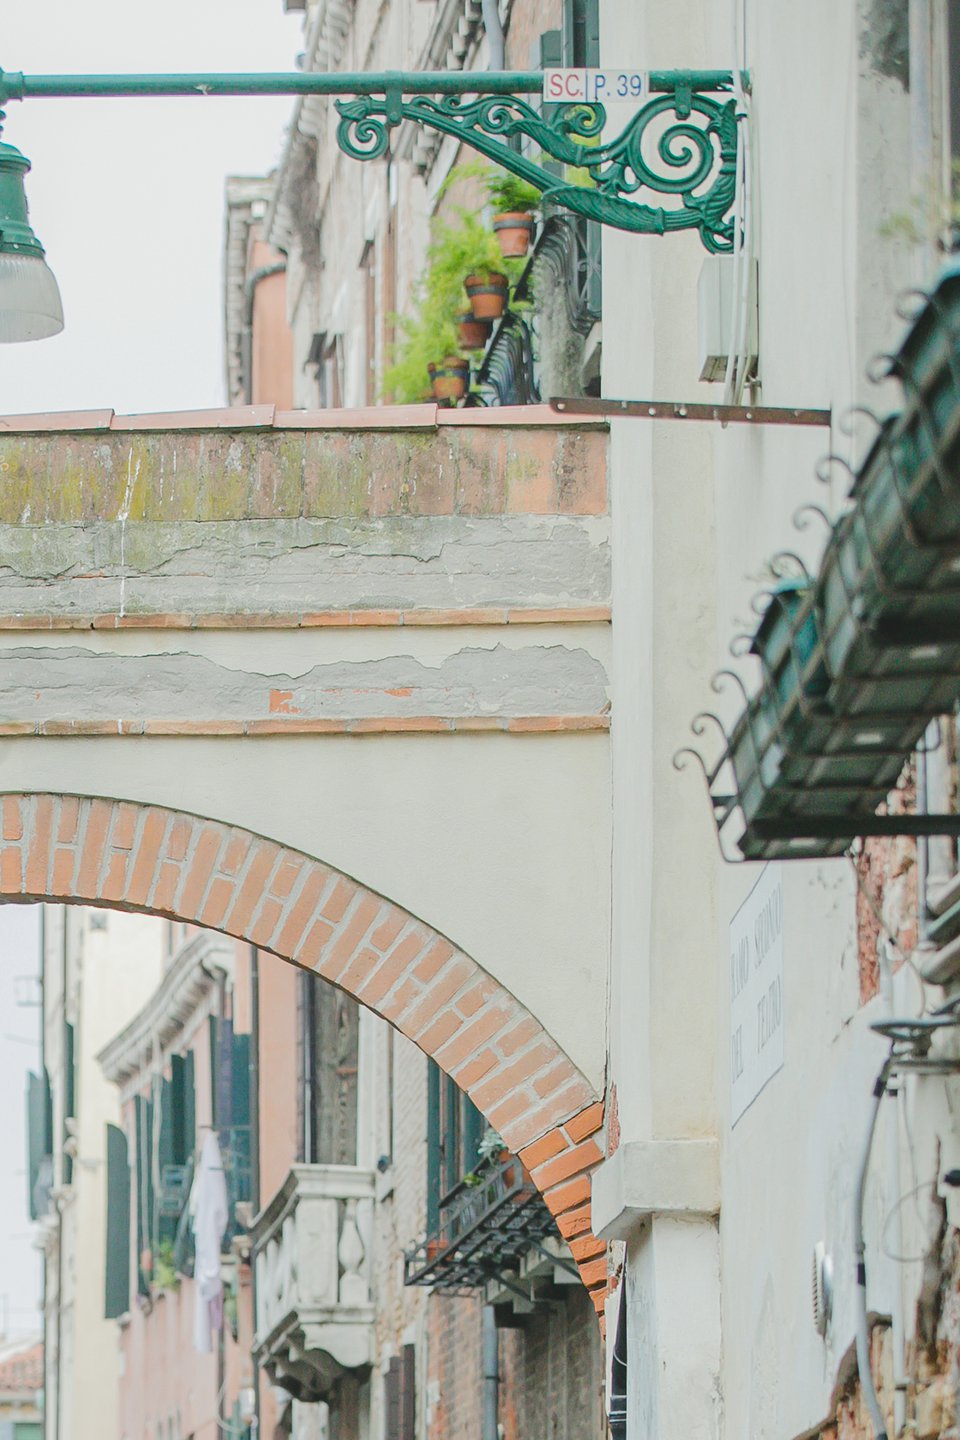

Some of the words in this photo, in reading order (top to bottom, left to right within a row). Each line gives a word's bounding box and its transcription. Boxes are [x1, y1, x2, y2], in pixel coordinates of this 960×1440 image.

[550, 74, 584, 97] SC.
[595, 74, 611, 97] P.
[617, 74, 642, 97] 39
